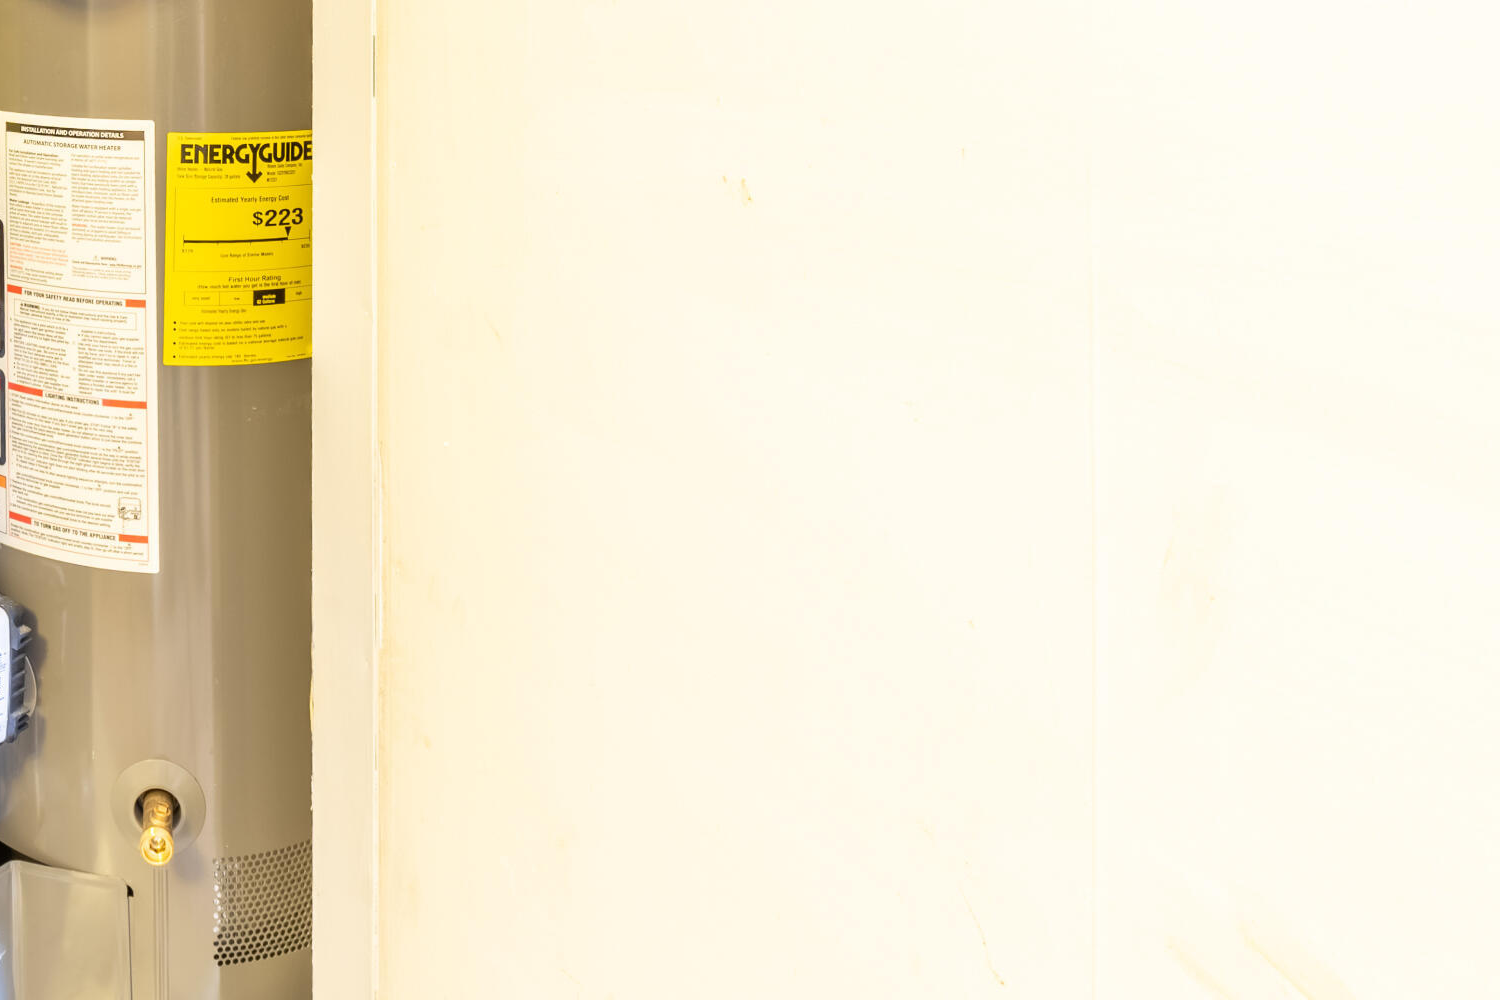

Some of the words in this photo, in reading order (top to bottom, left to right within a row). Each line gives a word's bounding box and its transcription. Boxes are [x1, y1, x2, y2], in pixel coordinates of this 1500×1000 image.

[21, 125, 55, 136] INSTALLATION
[68, 130, 100, 138] OPERATION
[23, 139, 52, 147] AUTOMATIC
[53, 141, 77, 149] STORAGE
[180, 141, 312, 164] ENERGYGUIDE
[252, 207, 303, 228] $223
[96, 299, 123, 307] OPERATING
[45, 393, 65, 401] LIGHTING
[66, 396, 100, 405] INSTRUCTIONS
[40, 521, 51, 529] TURN
[52, 524, 62, 532] GAS
[89, 531, 116, 541] APPLIANCE
